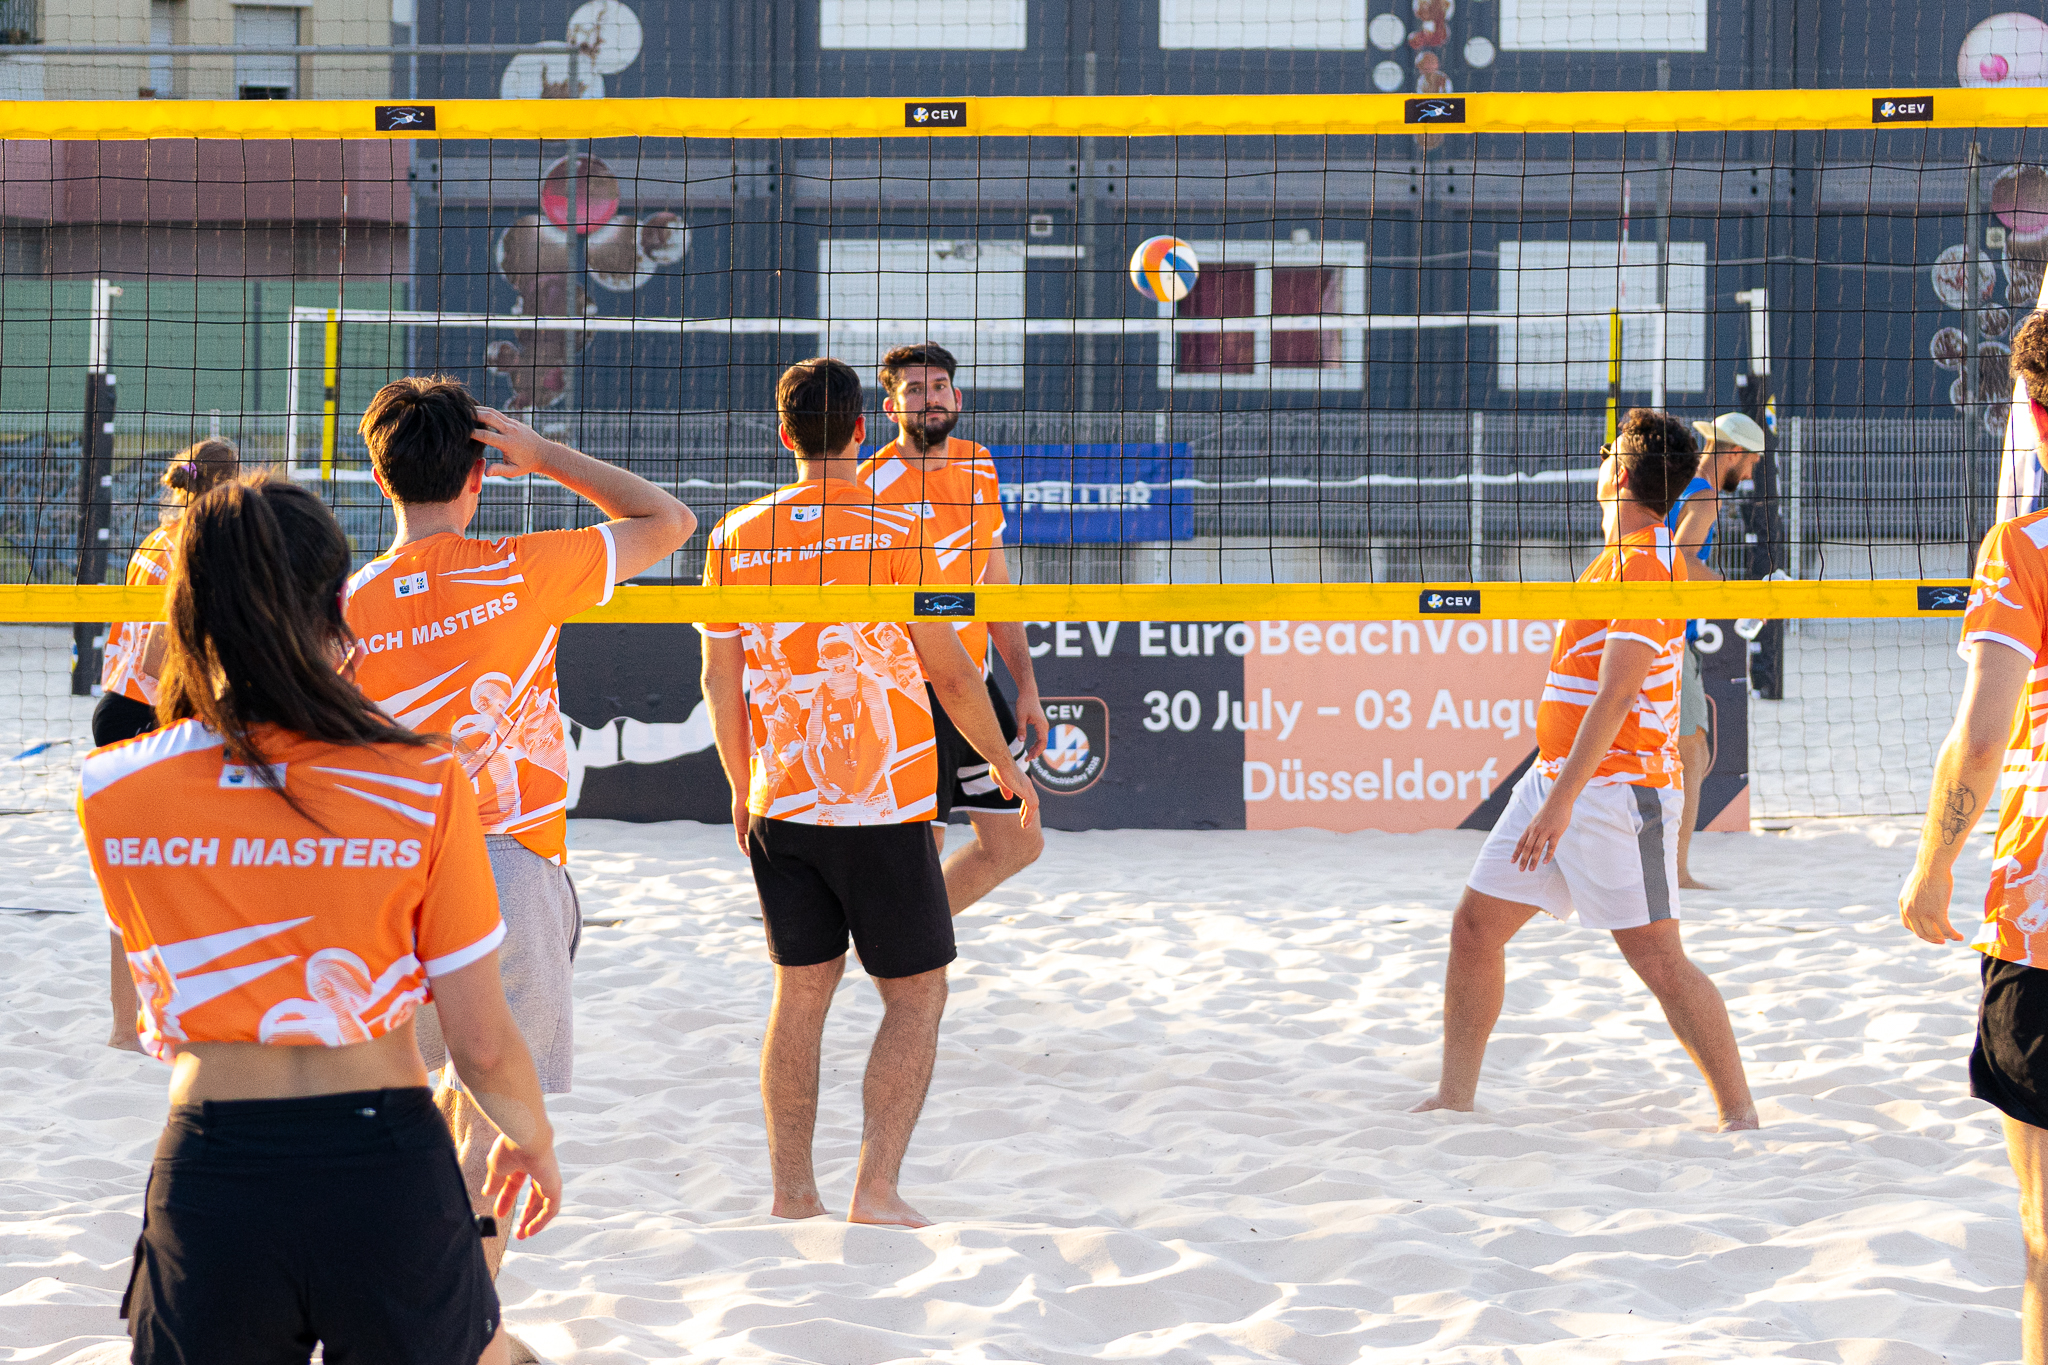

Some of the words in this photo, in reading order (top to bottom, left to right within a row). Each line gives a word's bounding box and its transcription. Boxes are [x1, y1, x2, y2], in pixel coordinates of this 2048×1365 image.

[931, 109, 958, 120] CEV
[1898, 103, 1926, 114] CEV
[1000, 487, 1152, 513] TPELLIER
[730, 546, 792, 572] BEACH
[799, 533, 893, 561] MASTERS
[1445, 596, 1472, 606] CEV
[354, 630, 403, 656] ACH
[412, 591, 518, 646] MASTERS
[1023, 620, 1120, 658] CEV
[1045, 704, 1084, 719] CEV
[1142, 689, 1201, 732] 30
[1211, 687, 1303, 740] July
[1354, 689, 1412, 730] 03
[1242, 757, 1498, 801] Düsseldorf
[104, 837, 220, 867] BEACH
[230, 838, 422, 869] MASTERS
